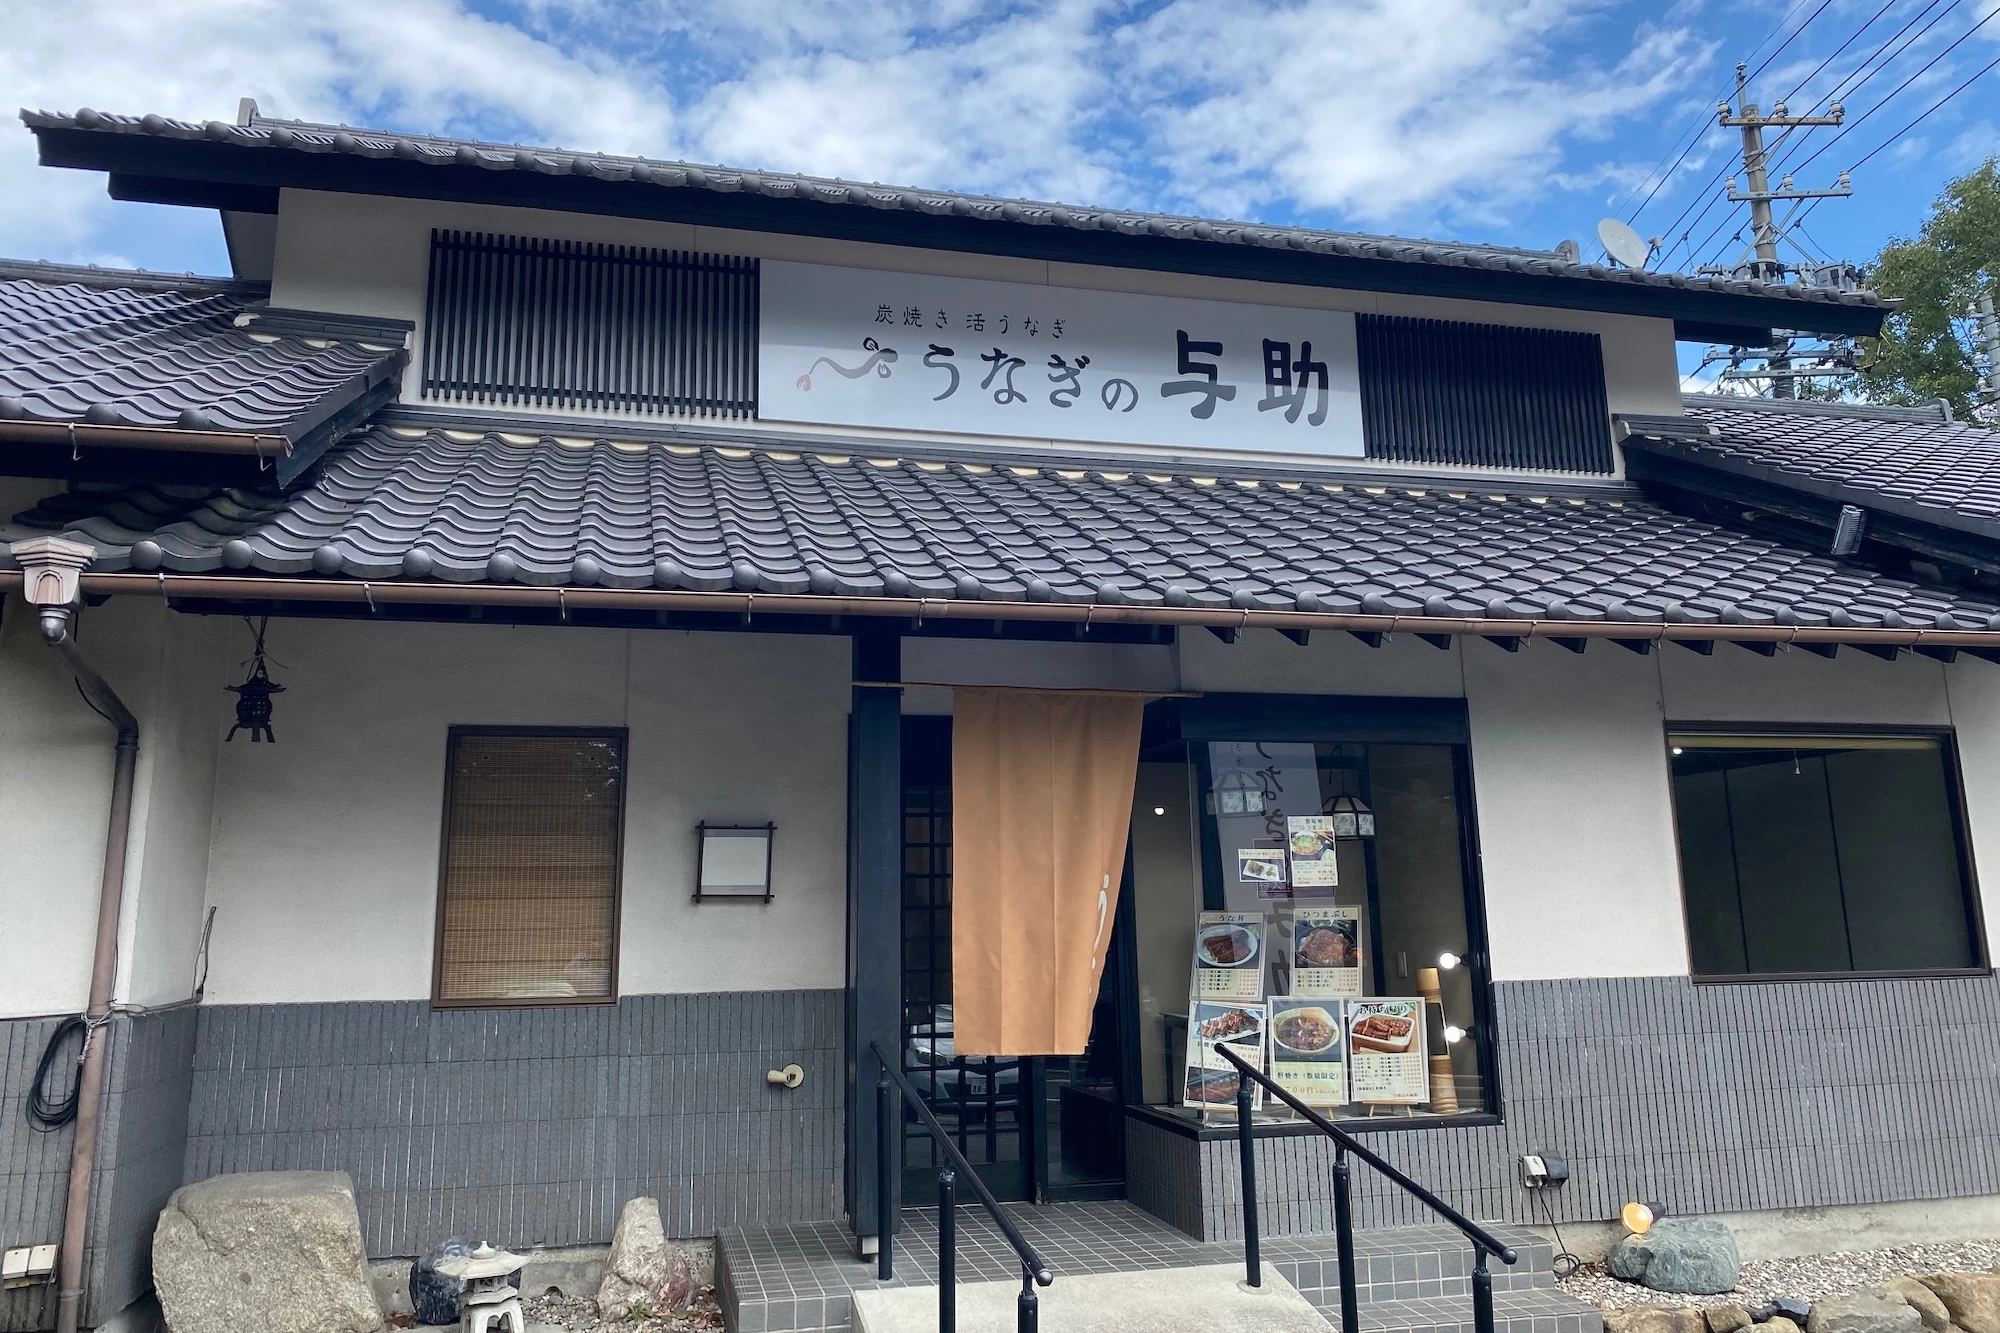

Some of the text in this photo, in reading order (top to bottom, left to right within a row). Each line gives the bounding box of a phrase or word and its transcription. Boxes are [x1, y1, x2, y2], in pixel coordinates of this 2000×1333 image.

[874, 303, 1067, 339] 炭焼き活うなぎ
[923, 329, 1329, 427] うなぎの与助
[1303, 910, 1348, 919] ひつまぶし
